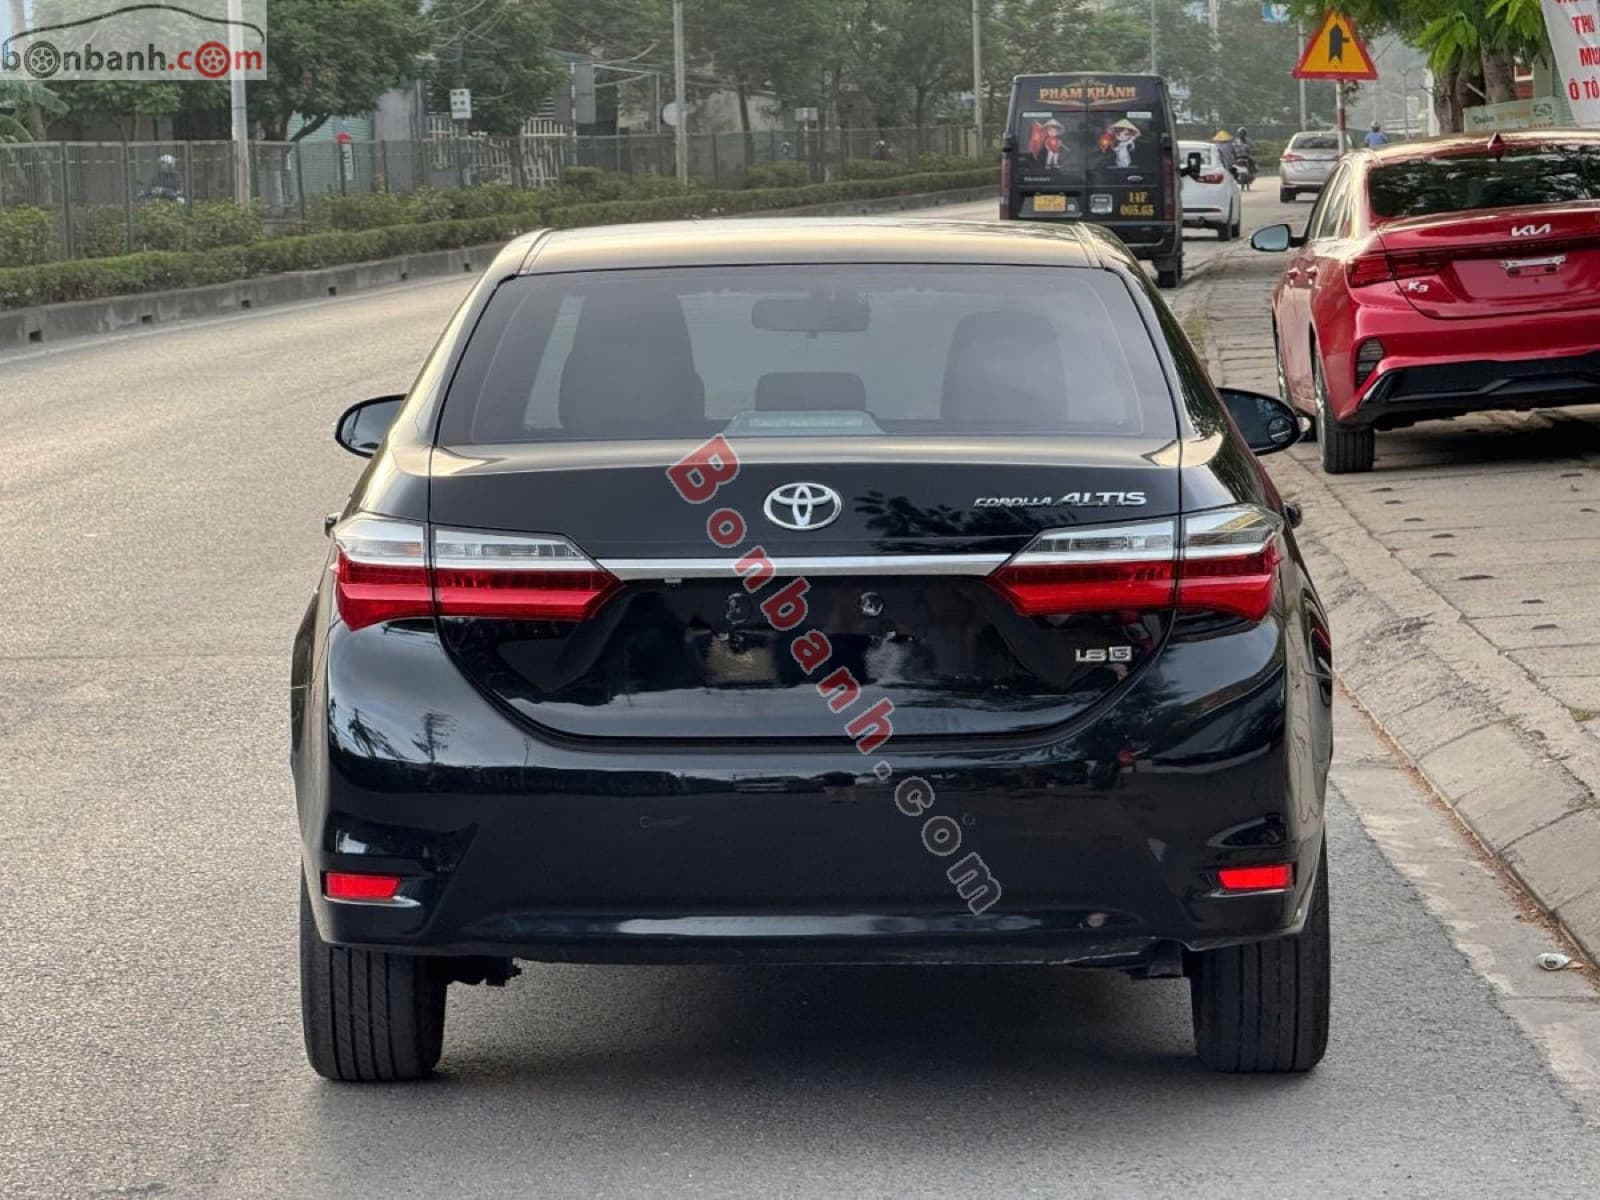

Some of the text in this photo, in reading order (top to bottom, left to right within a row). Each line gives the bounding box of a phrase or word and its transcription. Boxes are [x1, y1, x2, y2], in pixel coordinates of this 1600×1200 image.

[1569, 77, 1580, 100] Ô
[1511, 223, 1551, 237] KIA
[1408, 280, 1429, 293] K3
[974, 491, 1148, 508] COROLLA ALTIS
